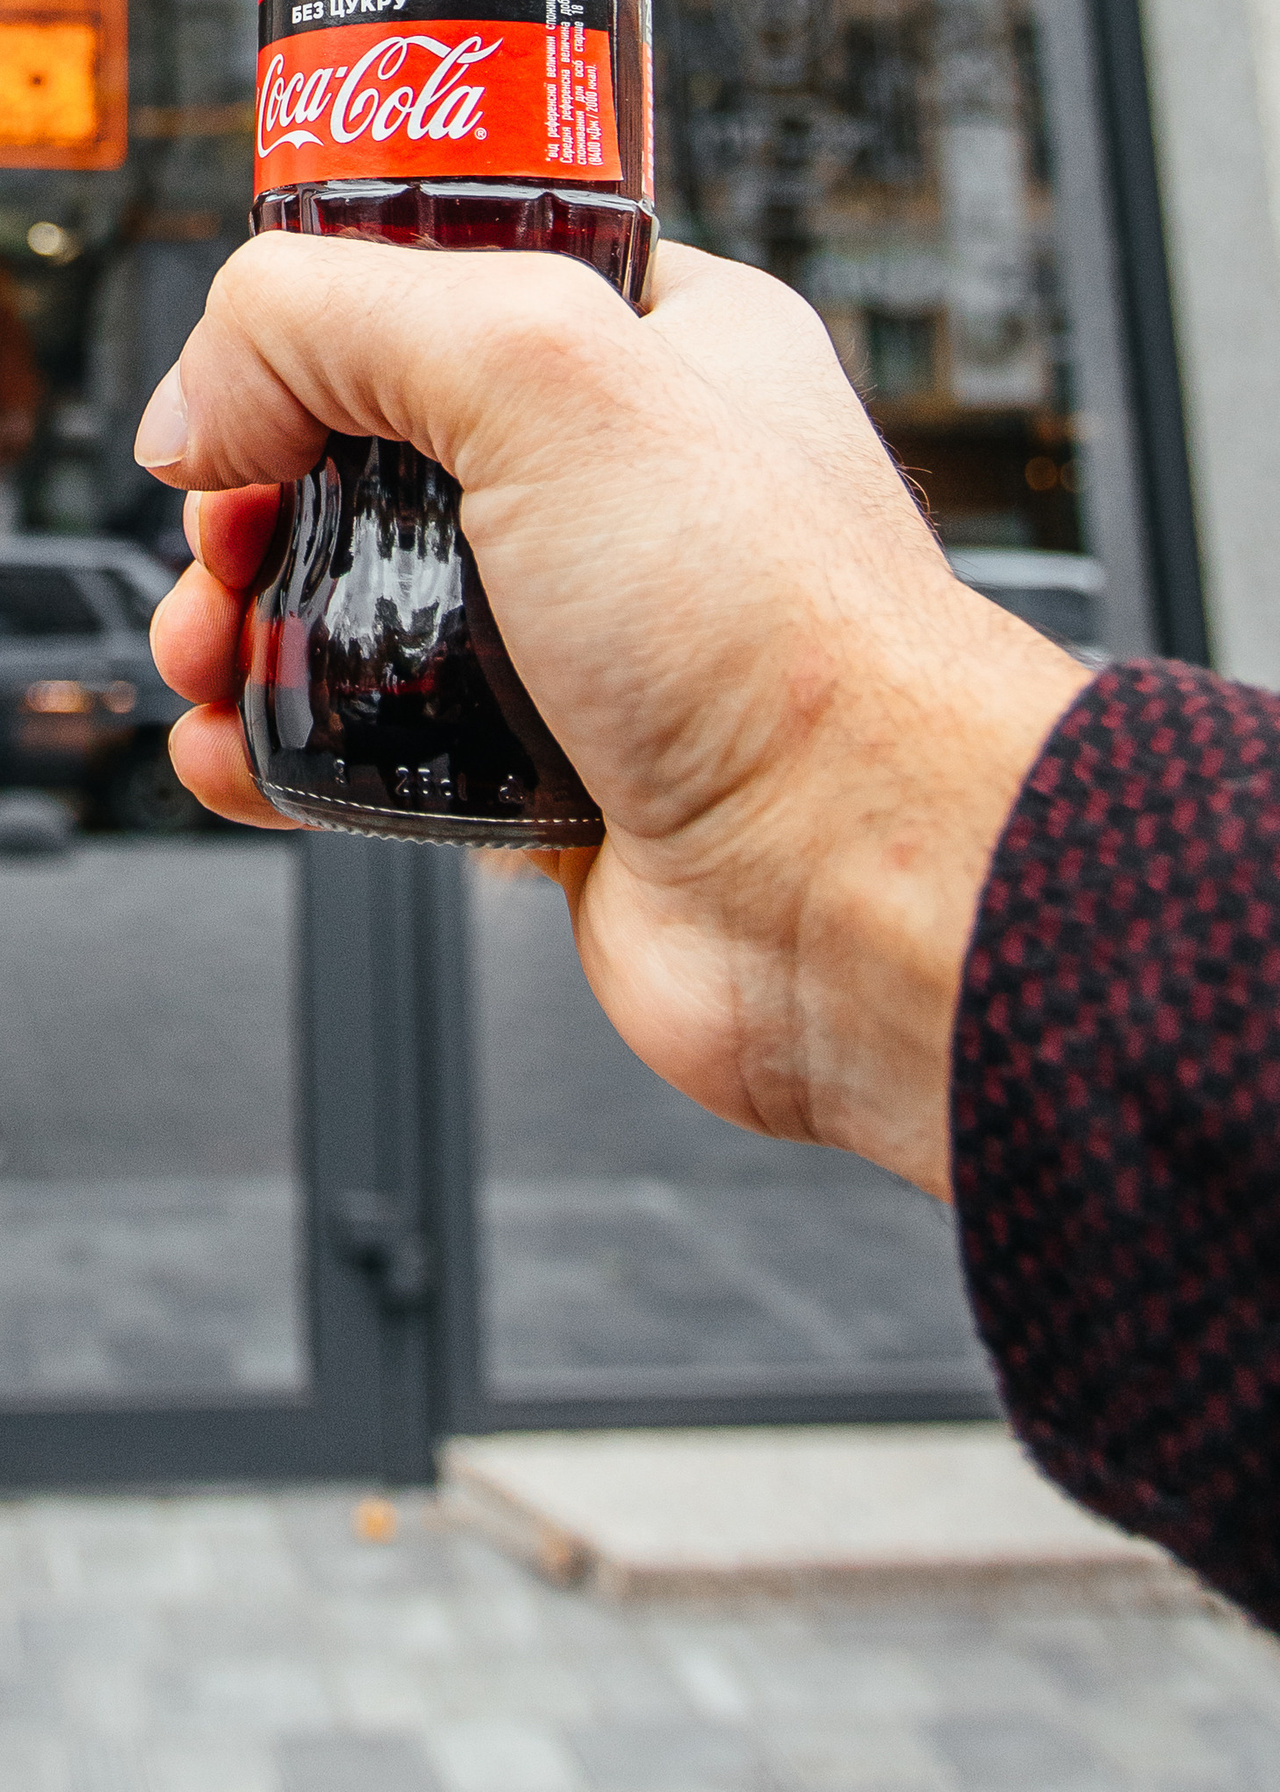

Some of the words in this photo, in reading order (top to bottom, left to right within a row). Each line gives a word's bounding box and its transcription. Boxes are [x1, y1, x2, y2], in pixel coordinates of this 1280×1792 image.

[291, 2, 324, 24] БЕЗ
[571, 4, 584, 15] 18
[560, 21, 572, 63] величина
[574, 21, 586, 52] старше
[546, 36, 557, 78] величини
[572, 60, 584, 78] осіб
[559, 69, 574, 121] референсна
[575, 85, 587, 103] для
[584, 91, 599, 113] 2000
[544, 83, 560, 138] референсної
[575, 111, 587, 165] споживання
[587, 120, 602, 140] кДж
[560, 127, 575, 163] Середня
[587, 142, 604, 166] (8400
